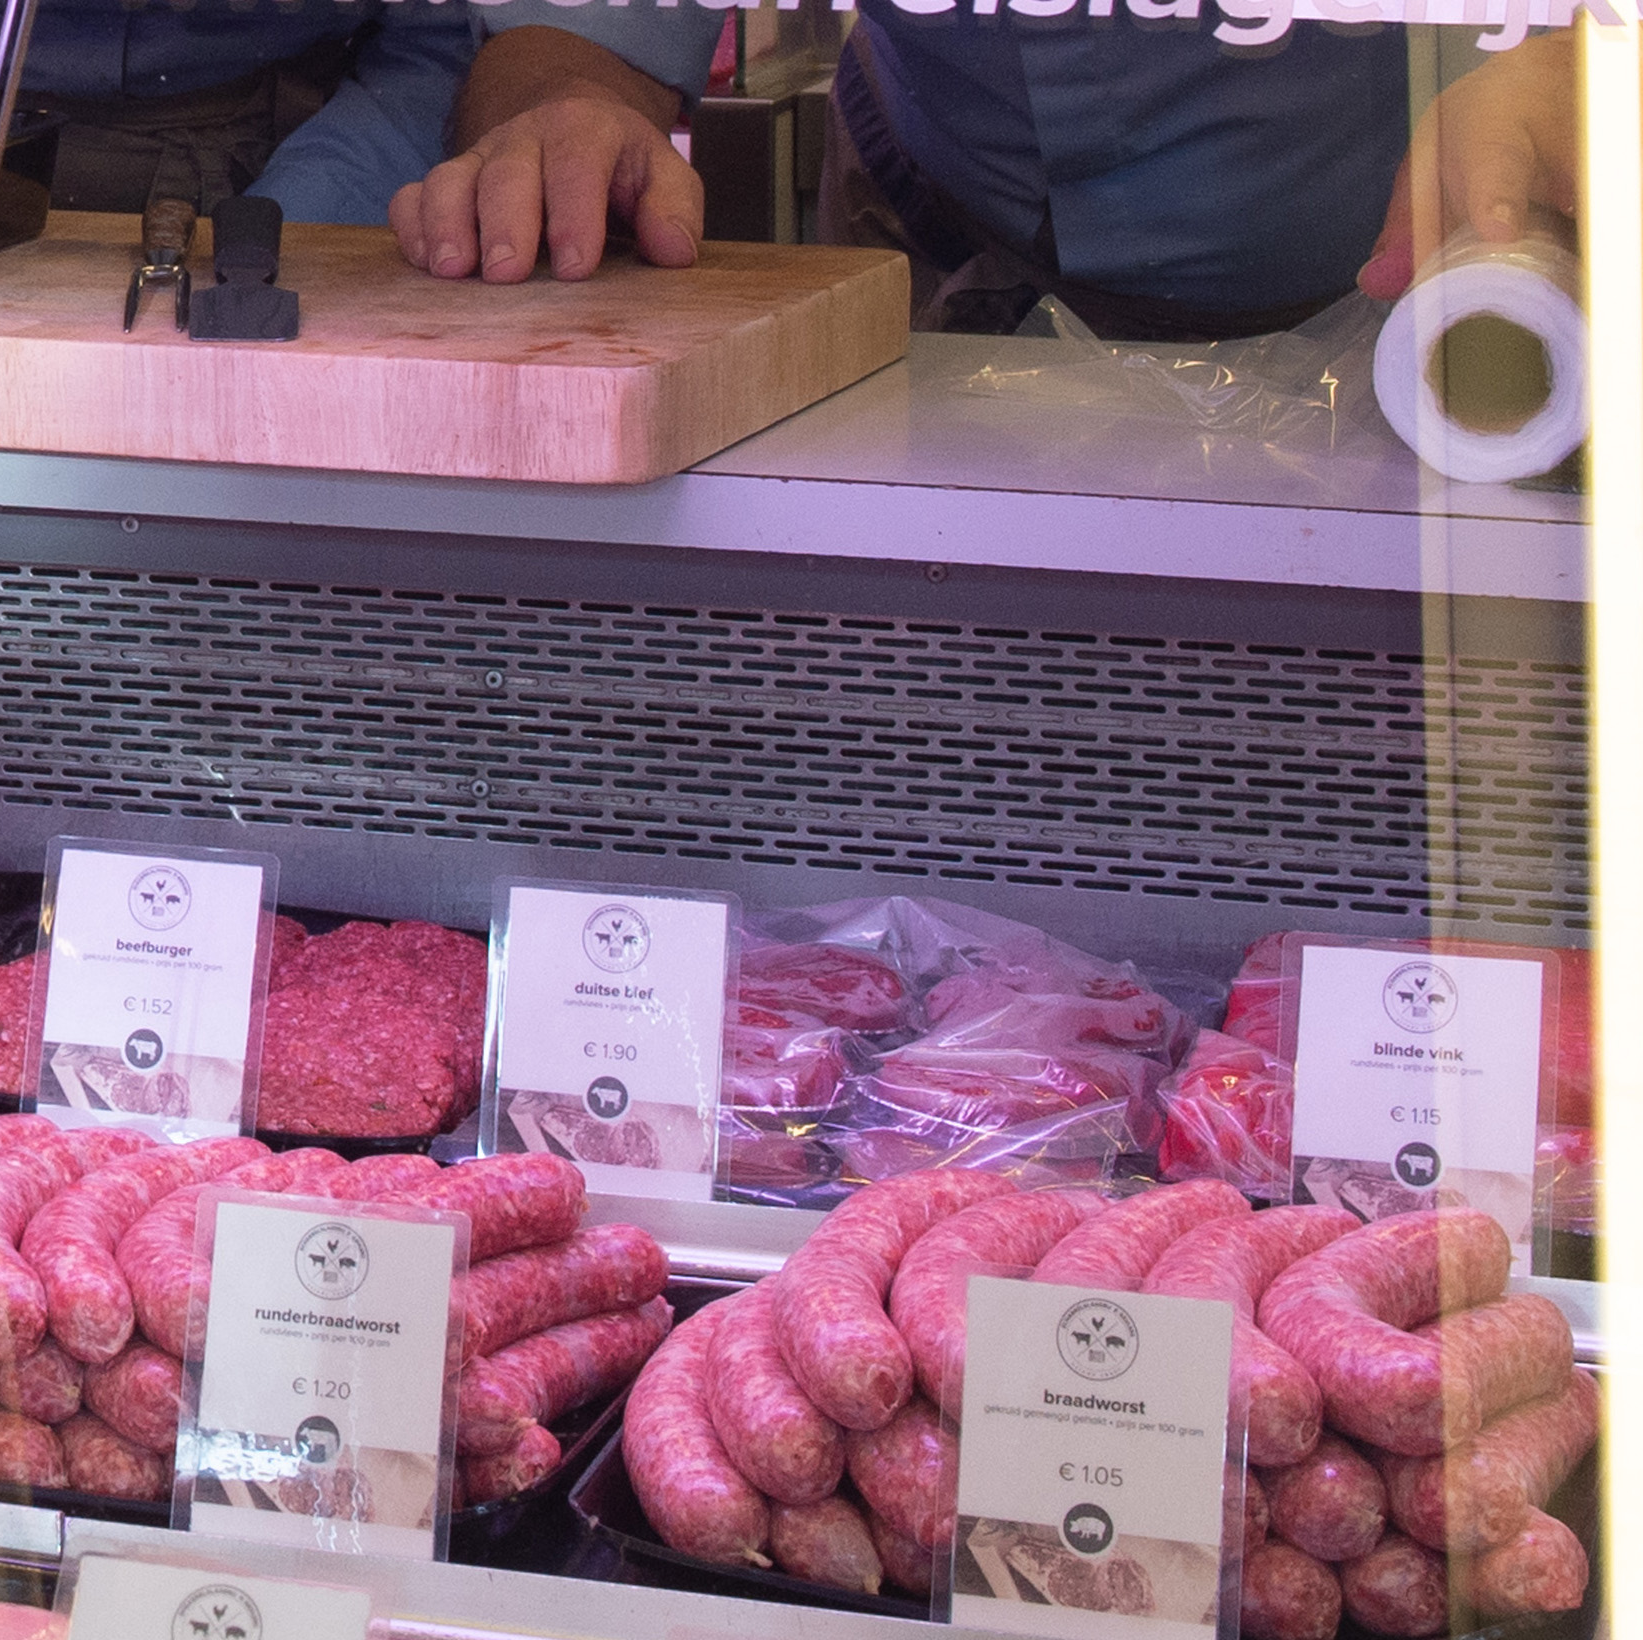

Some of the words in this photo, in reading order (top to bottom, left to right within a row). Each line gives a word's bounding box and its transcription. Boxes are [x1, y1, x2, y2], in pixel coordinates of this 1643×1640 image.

[116, 939, 193, 958] beefburger
[575, 982, 620, 997] duitse
[625, 986, 654, 1000] bief
[124, 996, 137, 1012] €
[141, 998, 173, 1015] 1.52
[584, 1042, 597, 1058] €
[603, 1043, 638, 1061] 1.90
[1374, 1042, 1424, 1058] blinde
[1429, 1047, 1464, 1061] vink
[1390, 1106, 1405, 1122] €
[1411, 1107, 1442, 1126] 1.15
[255, 1308, 401, 1335] runderbraadworst
[292, 1377, 307, 1395] €
[313, 1379, 351, 1400] 1.20
[1043, 1389, 1146, 1415] braadworst
[1059, 1462, 1076, 1481] €
[1082, 1465, 1124, 1487] 1.05
